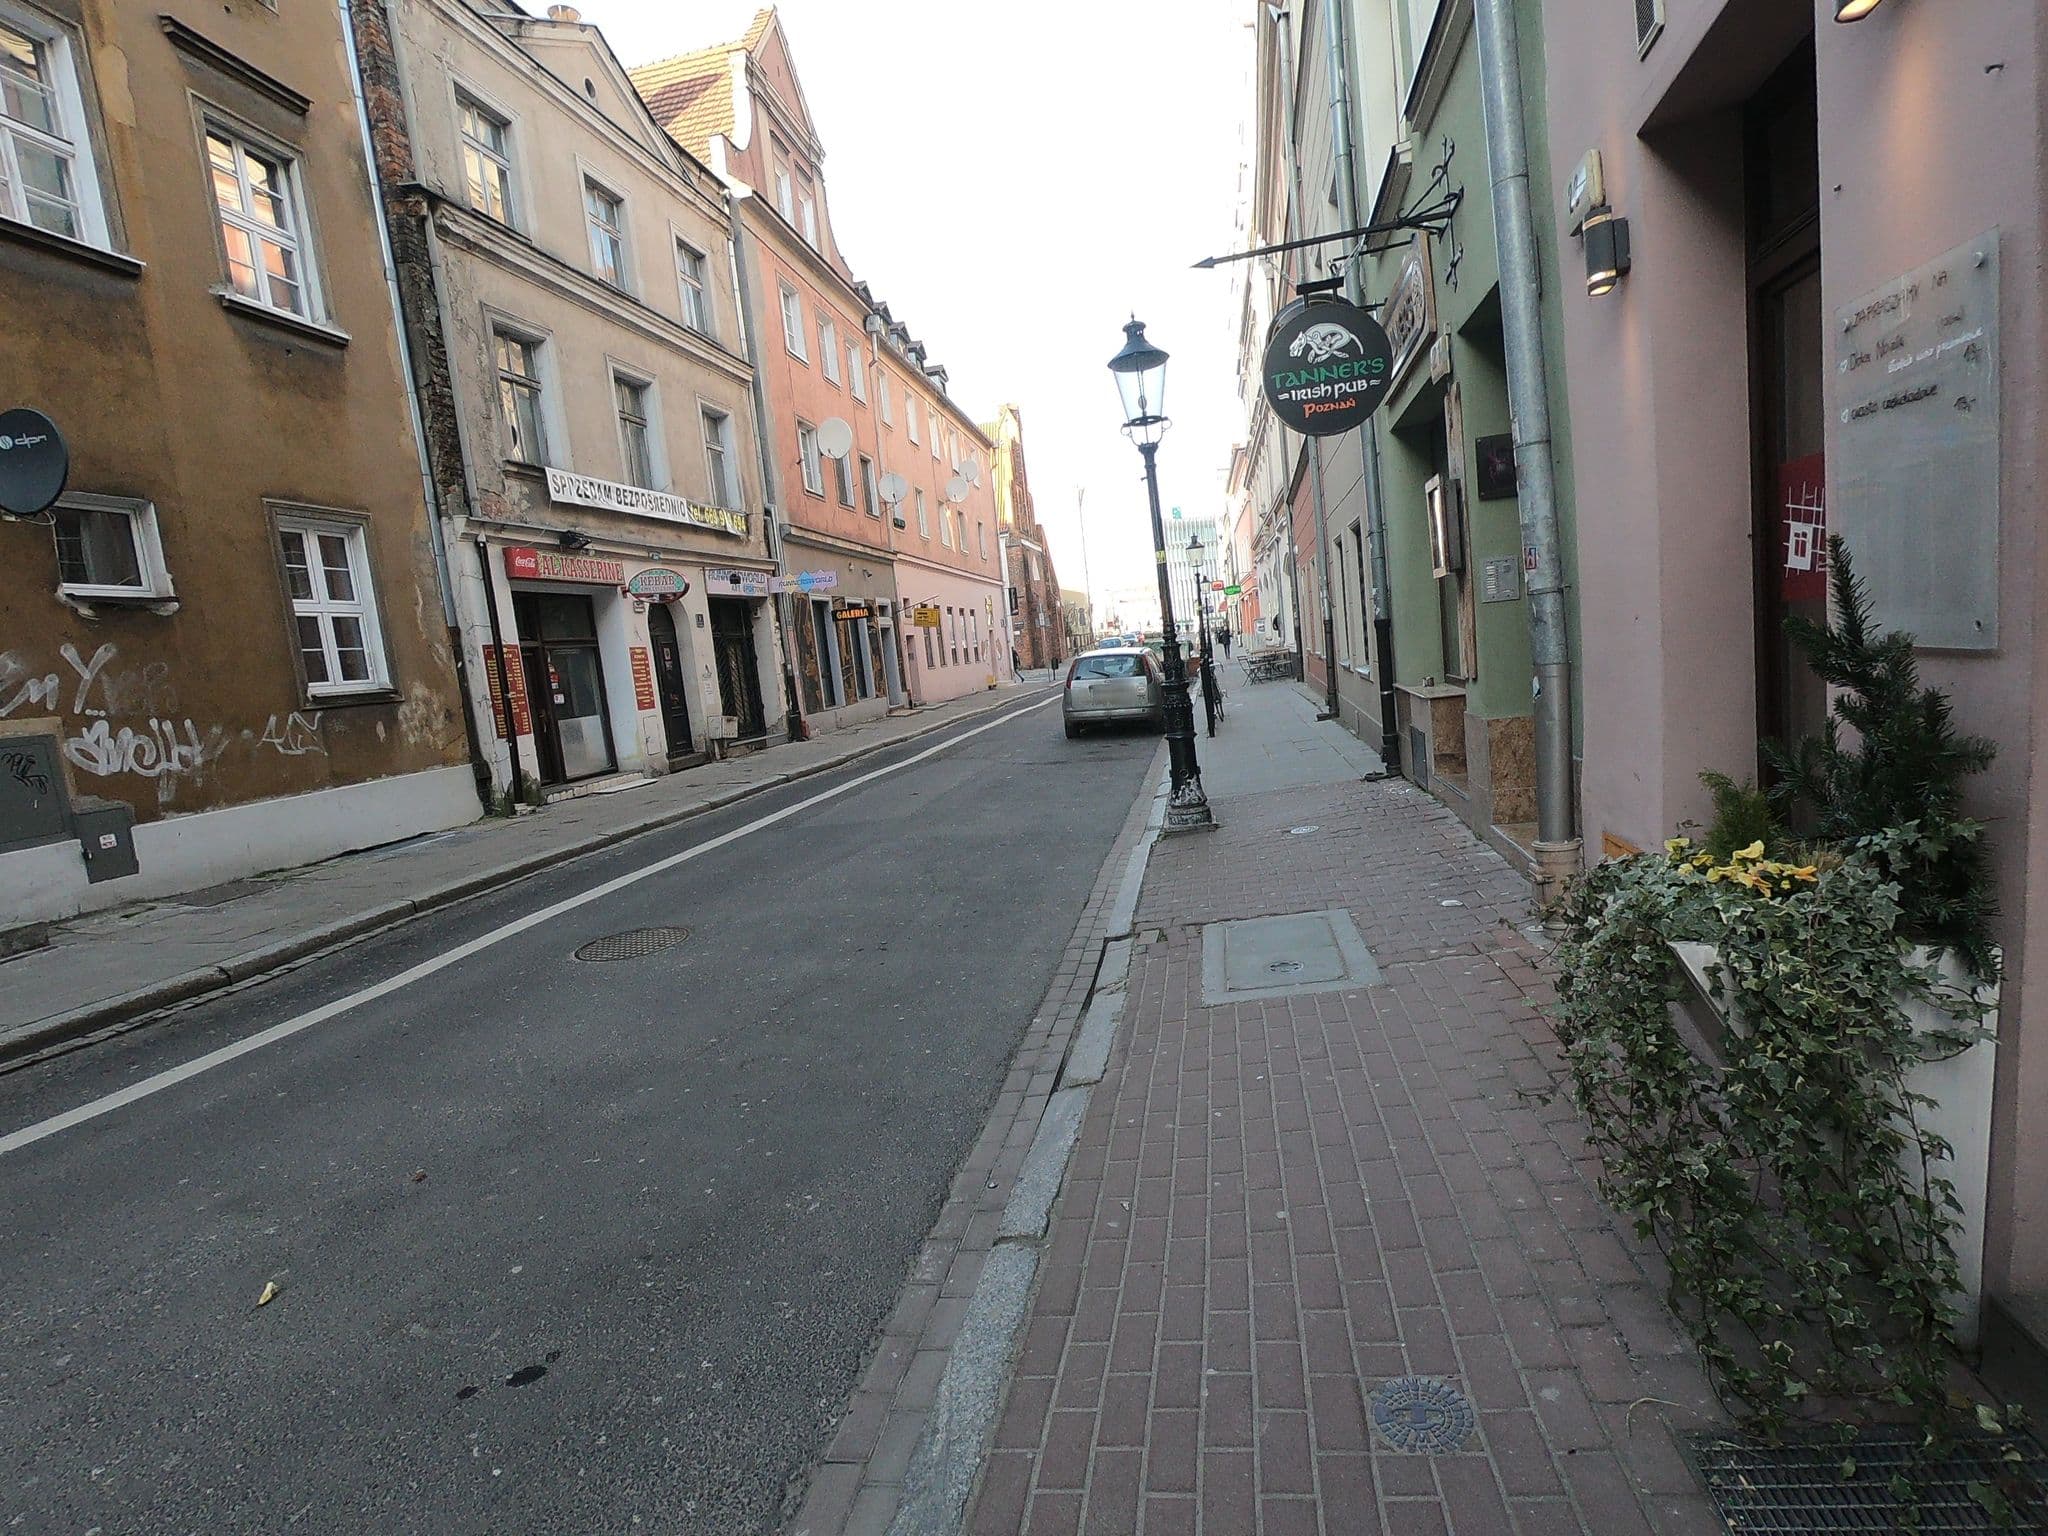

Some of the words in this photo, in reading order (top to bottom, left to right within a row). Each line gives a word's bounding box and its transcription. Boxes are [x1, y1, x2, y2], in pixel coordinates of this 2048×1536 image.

[1271, 358, 1385, 389] TANNER'S
[560, 557, 622, 580] KASSERINE
[640, 575, 675, 586] KEBAB
[836, 608, 868, 620] GALERIA
